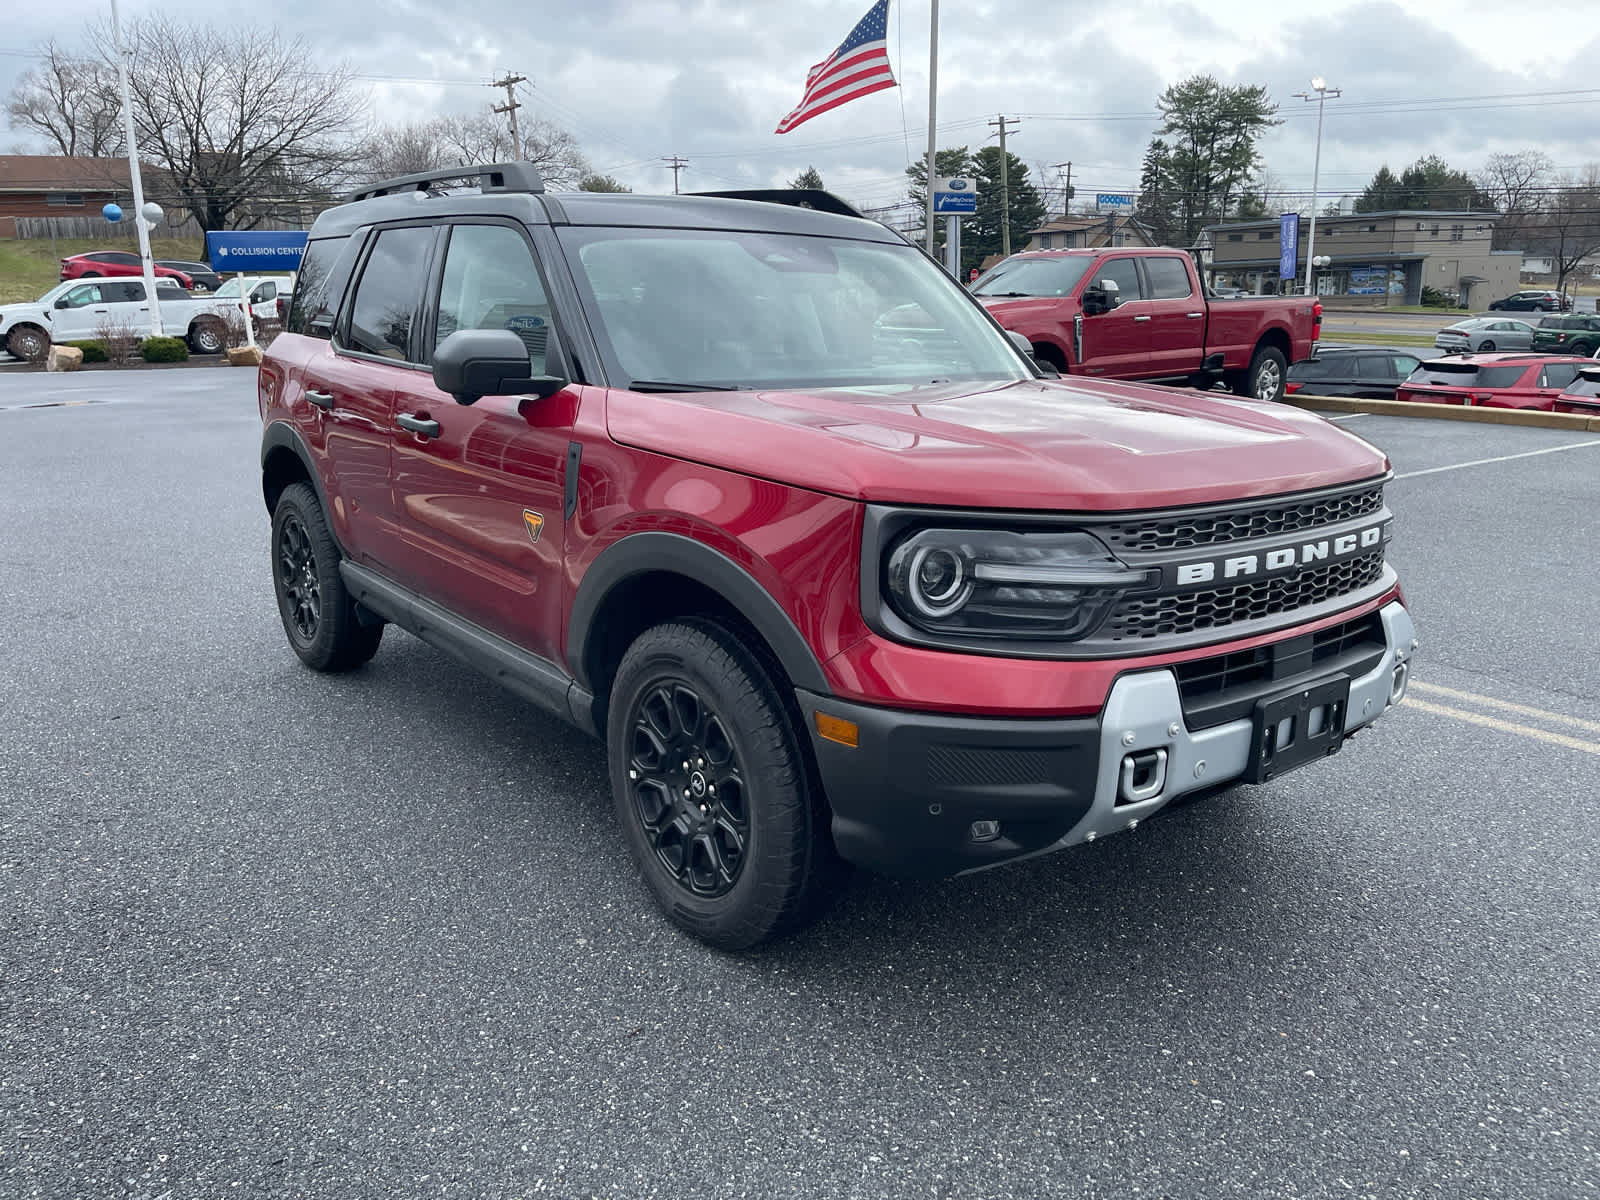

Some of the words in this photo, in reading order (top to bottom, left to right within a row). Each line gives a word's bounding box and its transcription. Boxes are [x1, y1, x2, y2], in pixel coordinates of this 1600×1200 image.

[1099, 194, 1131, 206] GOODALL
[231, 247, 275, 256] COLLISION
[277, 247, 304, 256] CENTE
[1177, 527, 1380, 585] BRONCO
